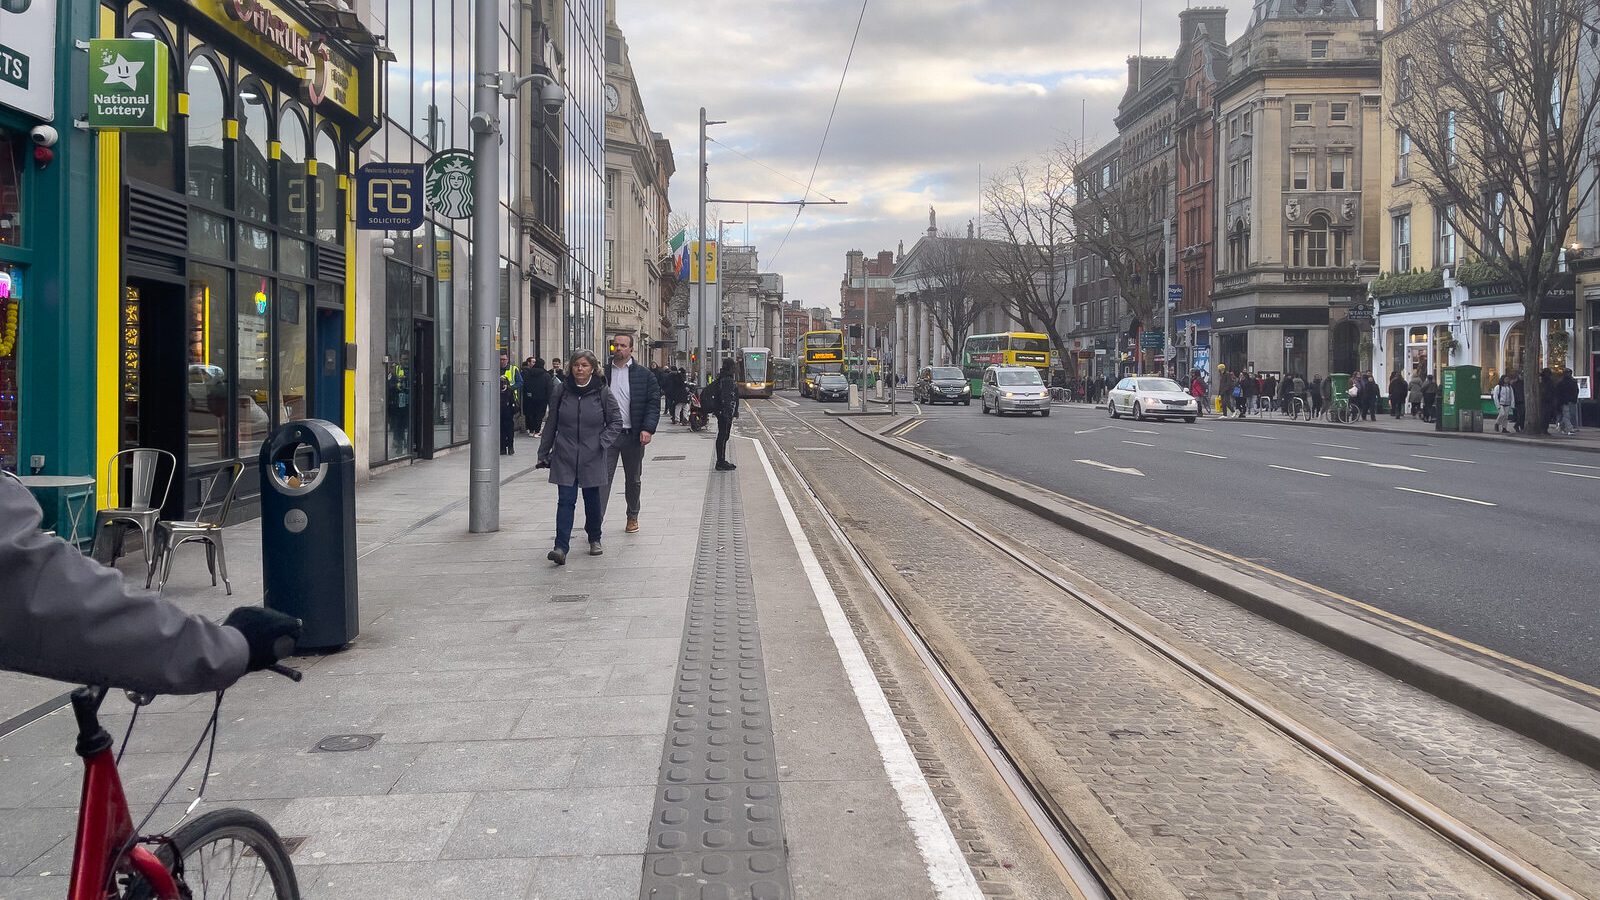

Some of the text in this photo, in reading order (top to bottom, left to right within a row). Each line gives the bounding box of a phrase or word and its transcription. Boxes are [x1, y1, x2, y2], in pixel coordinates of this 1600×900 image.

[93, 94, 149, 105] National
[97, 105, 146, 118] Lottery
[368, 178, 411, 213] AG
